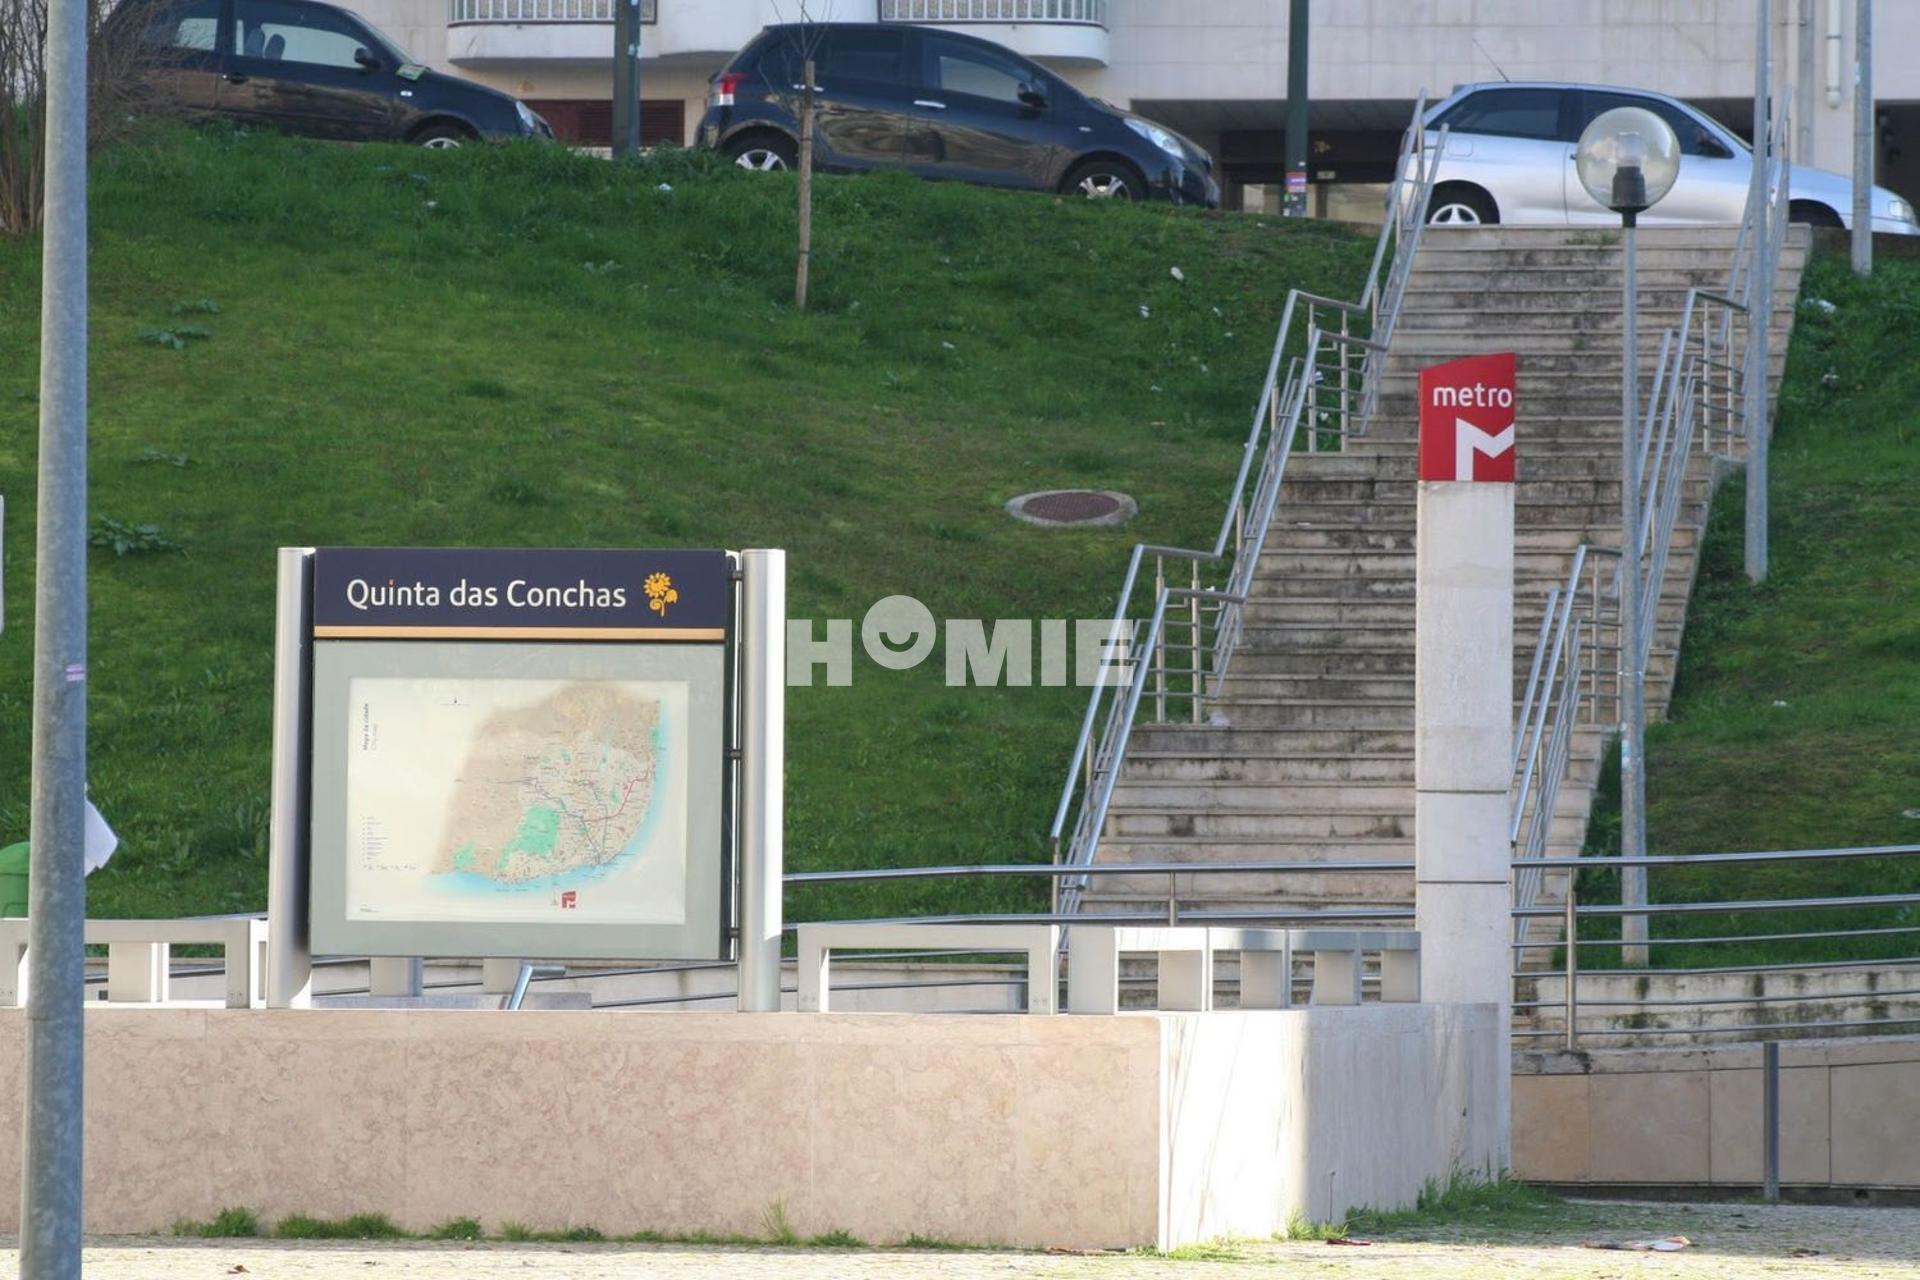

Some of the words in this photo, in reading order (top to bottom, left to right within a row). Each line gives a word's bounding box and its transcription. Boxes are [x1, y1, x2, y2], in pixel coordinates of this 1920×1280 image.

[1432, 382, 1513, 408] metro
[346, 578, 440, 610] Quinta
[449, 578, 498, 607] das
[506, 579, 627, 608] Conchas
